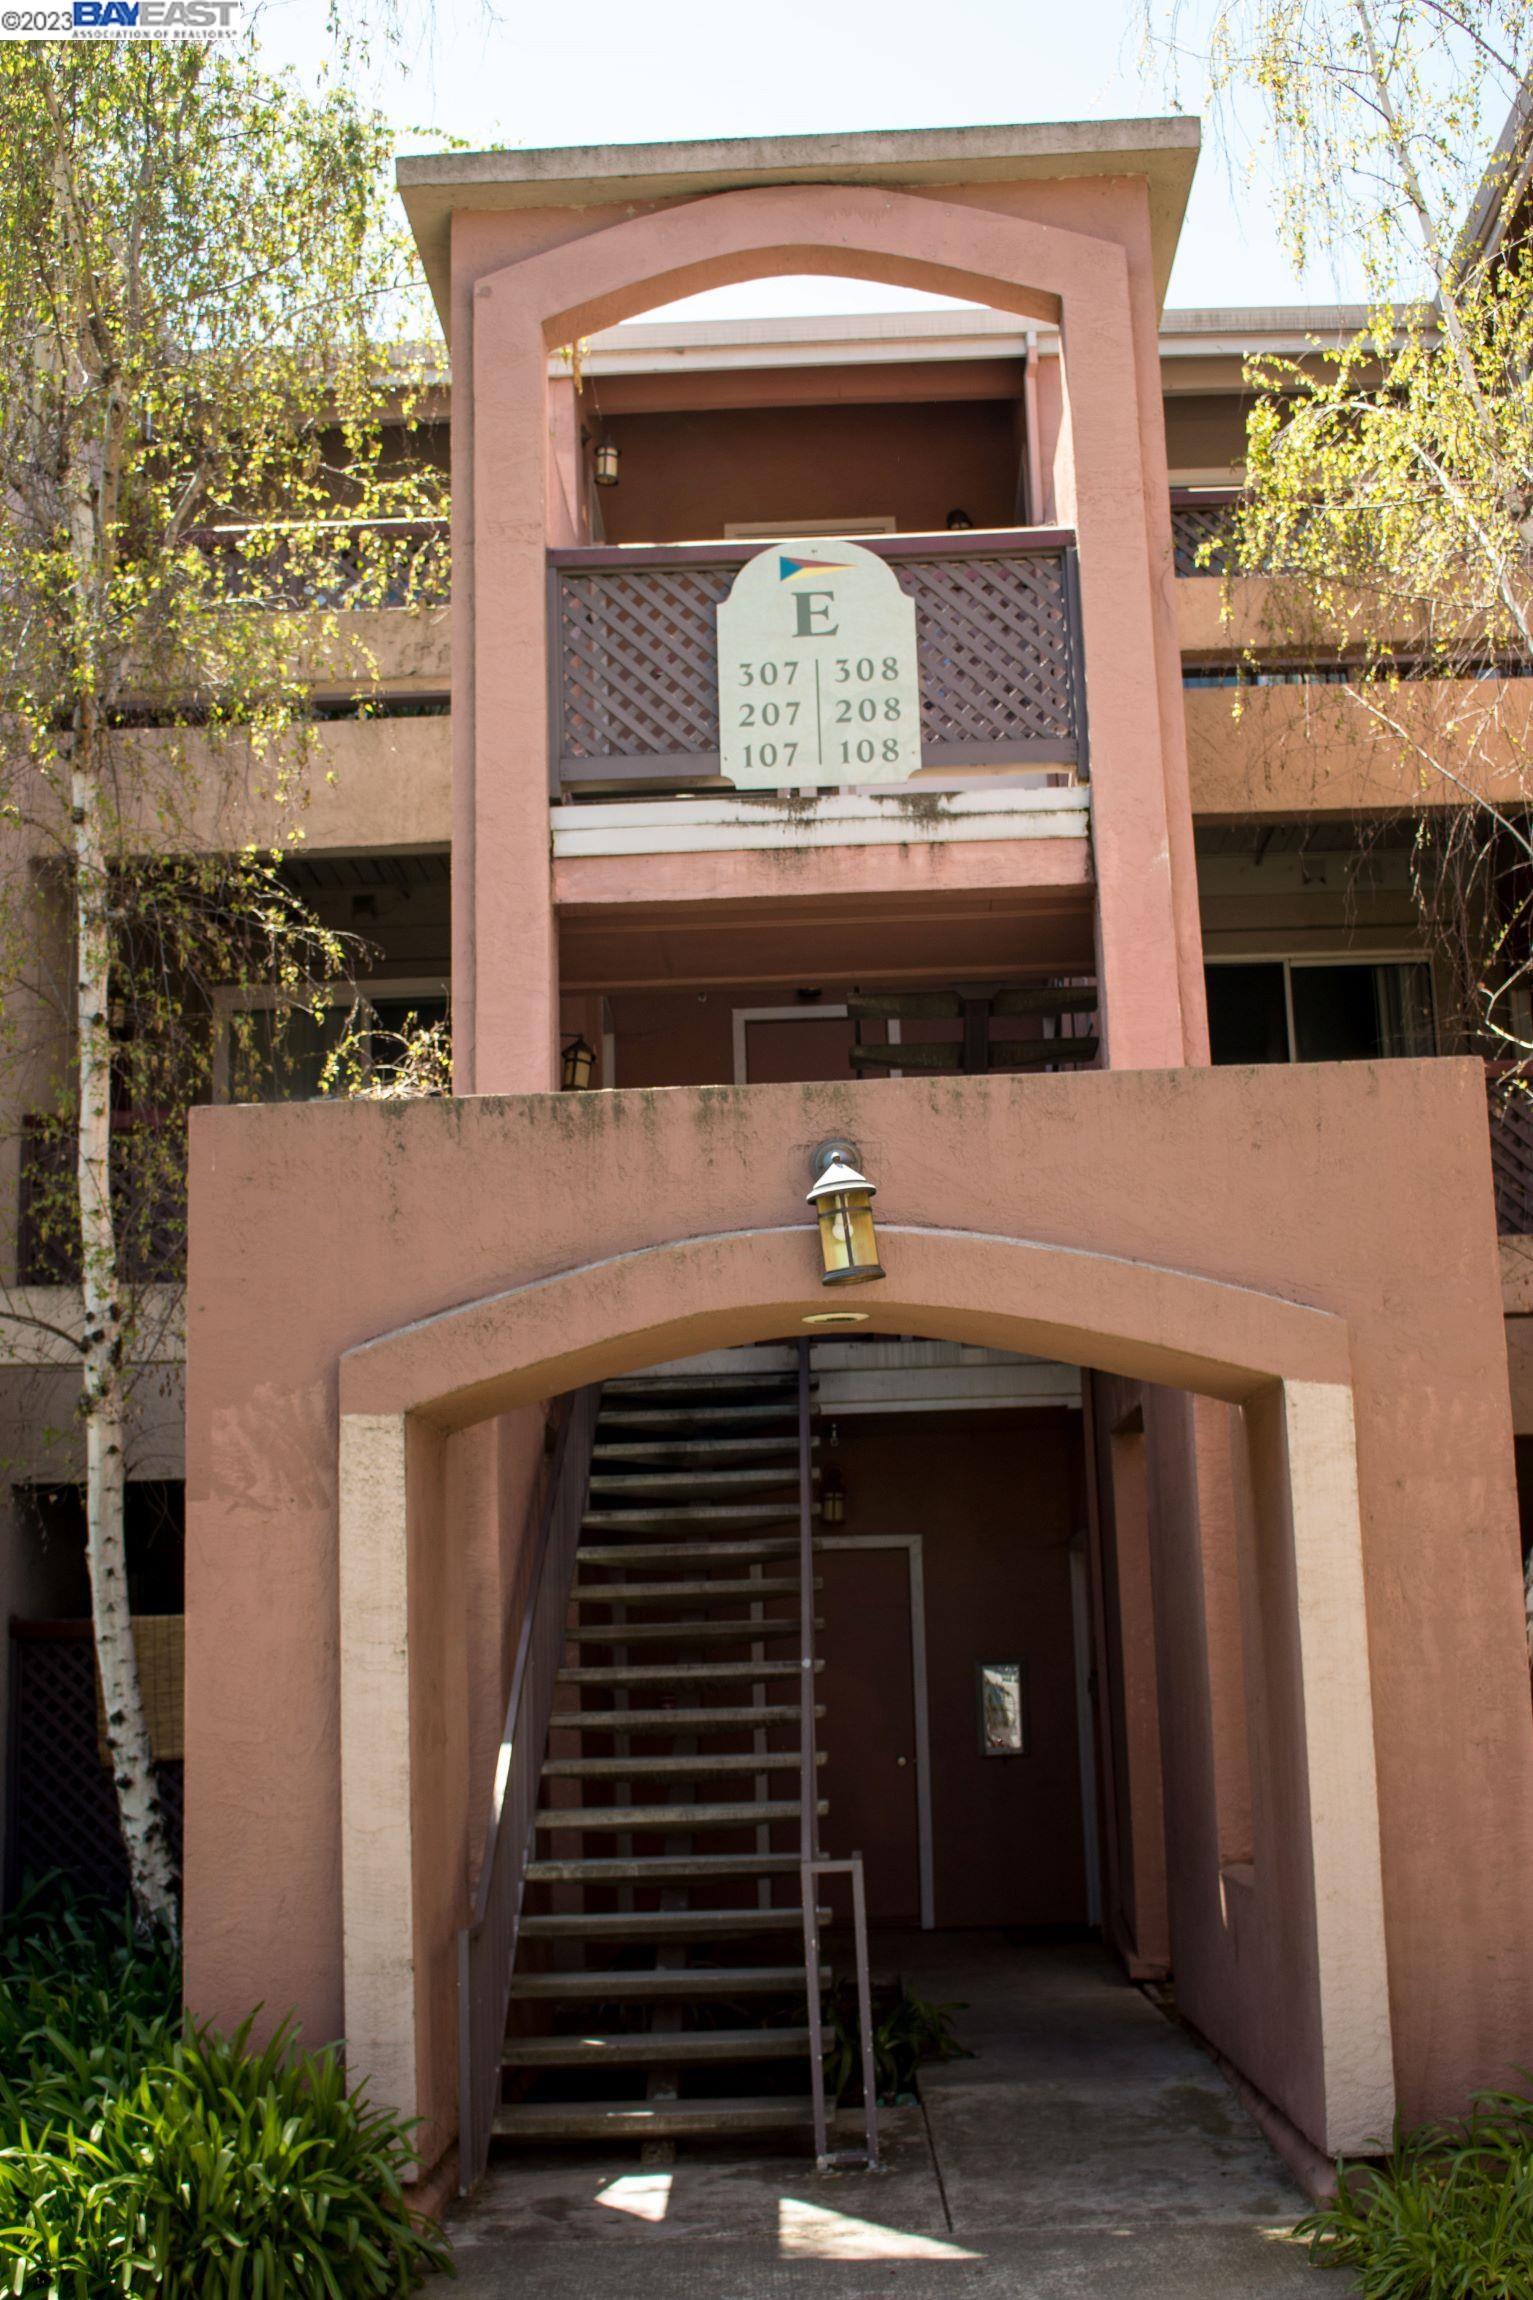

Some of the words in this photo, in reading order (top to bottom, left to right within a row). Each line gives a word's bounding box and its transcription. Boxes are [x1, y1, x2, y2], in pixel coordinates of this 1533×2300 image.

[791, 590, 840, 638] E
[738, 661, 799, 687] 307
[834, 656, 899, 683] 308
[738, 702, 801, 728] 207
[834, 697, 902, 724] 208
[743, 743, 799, 769] 107
[840, 738, 900, 765] 108
